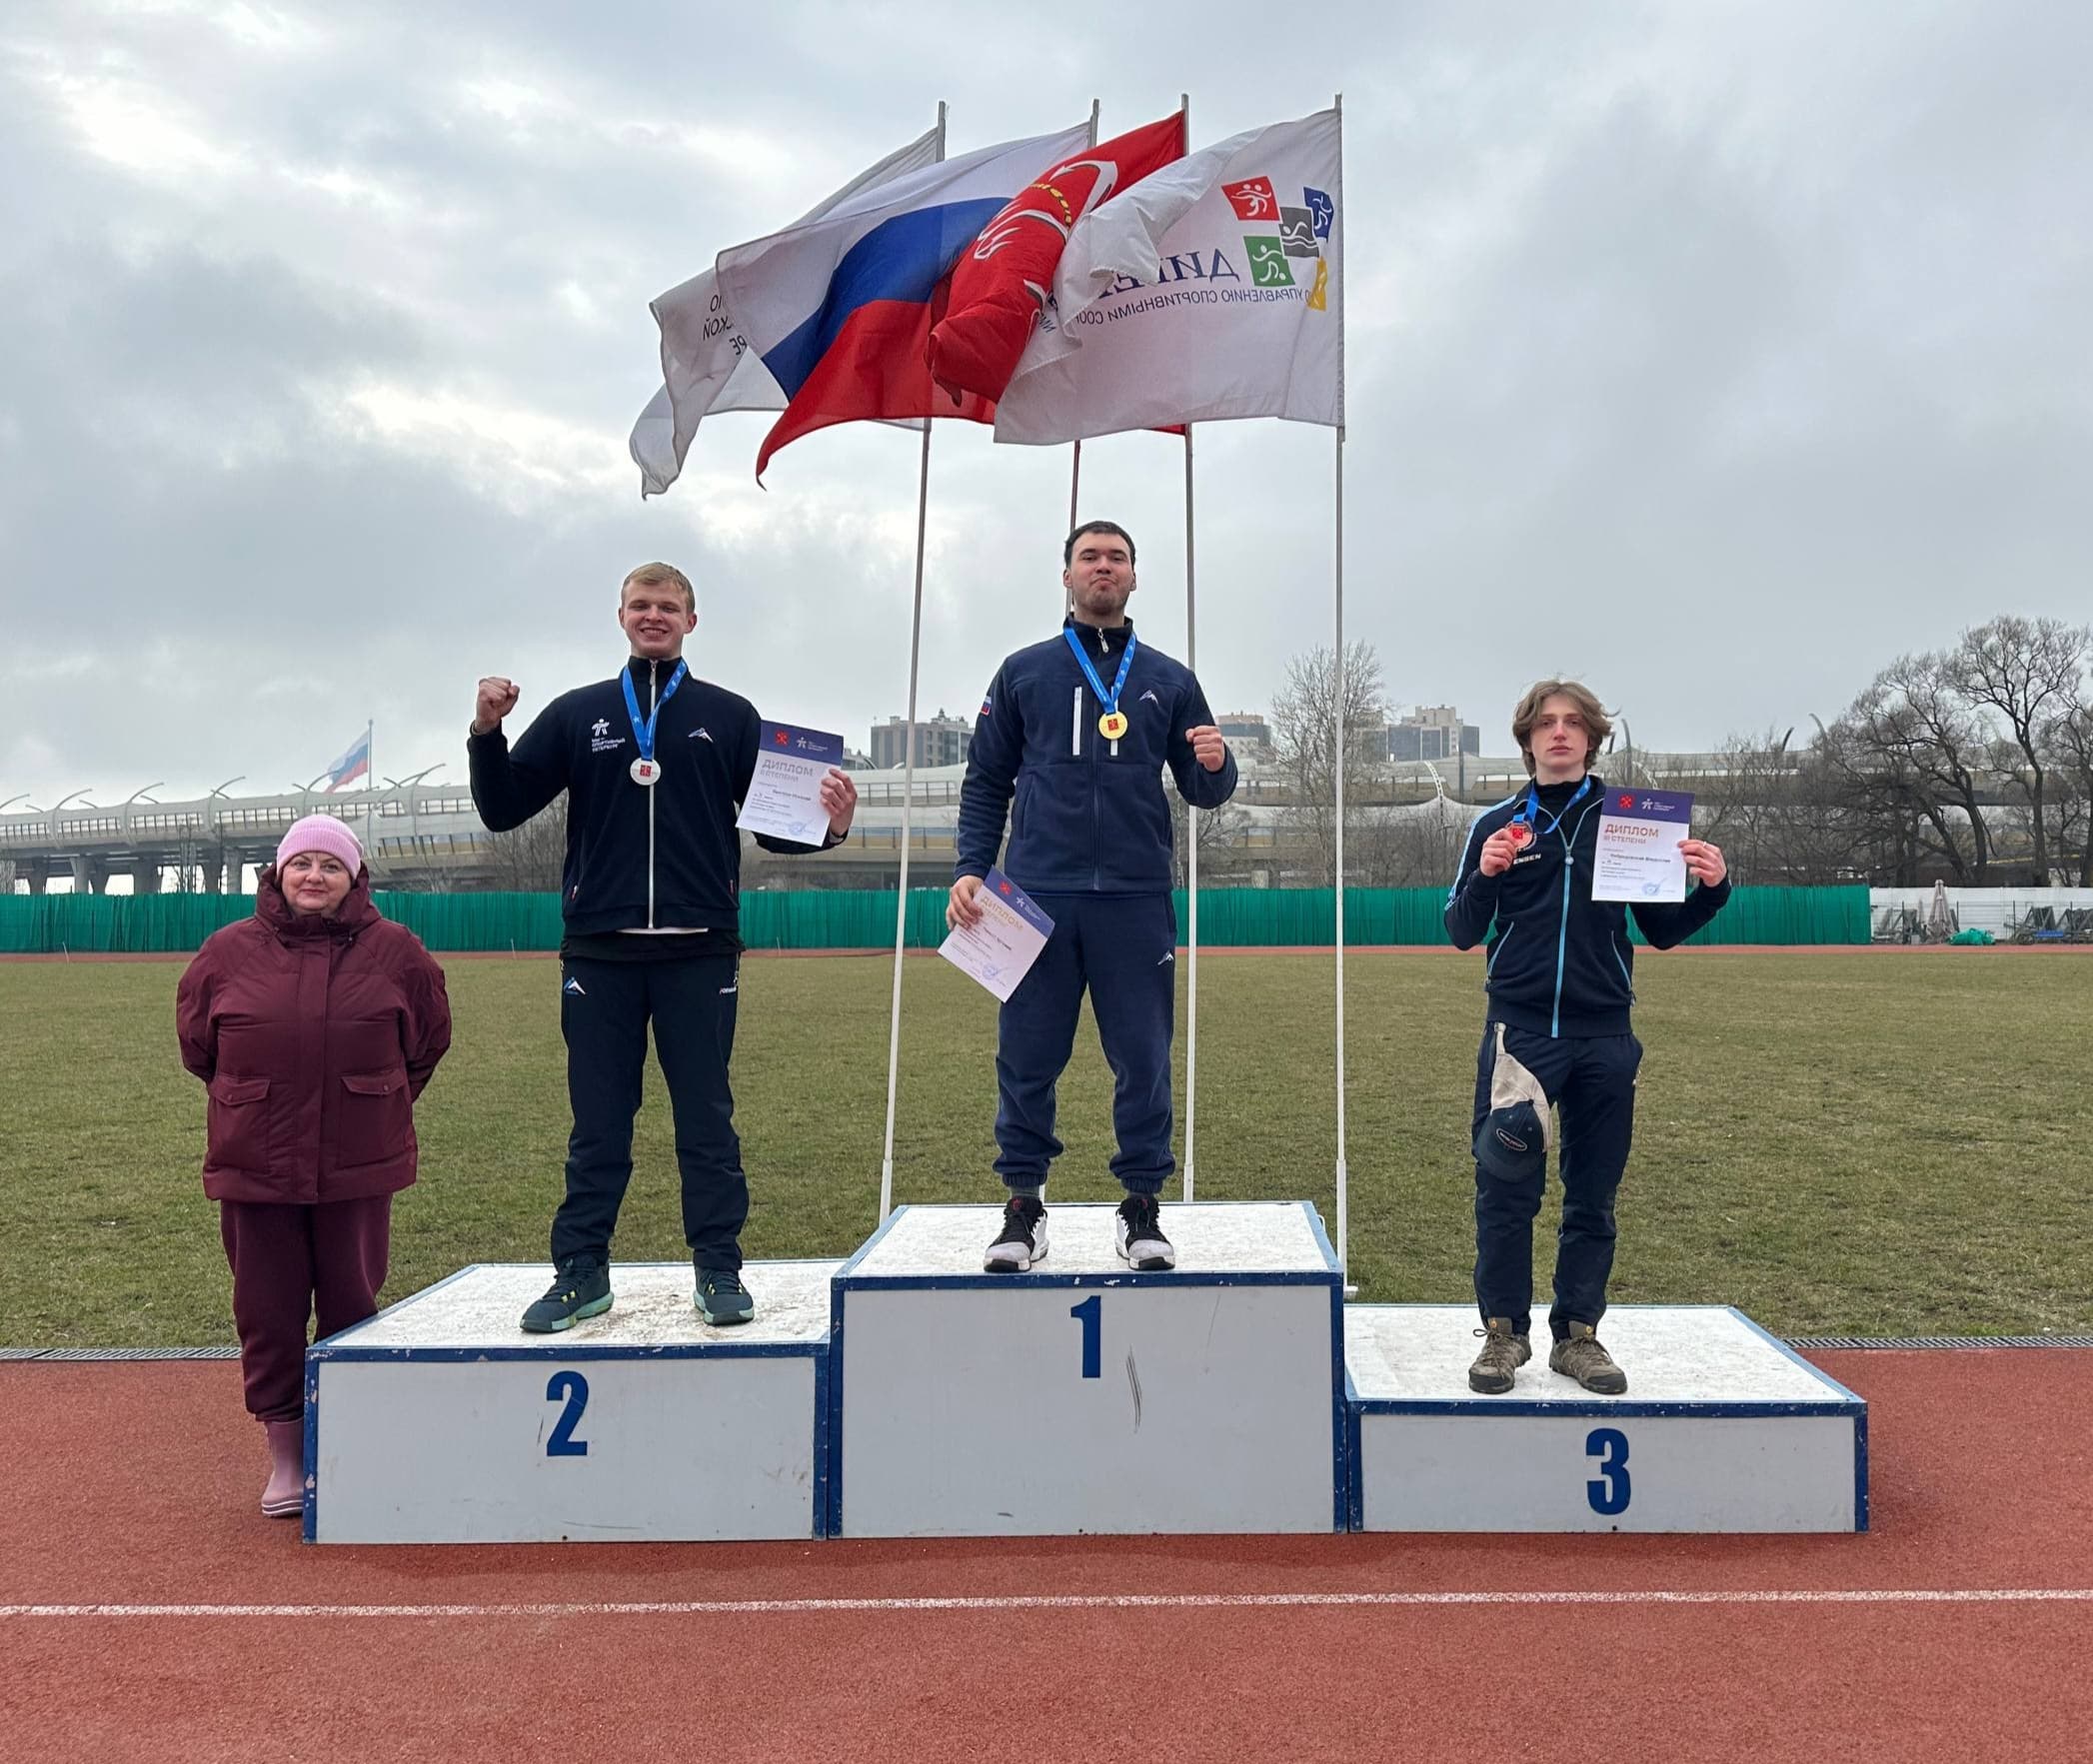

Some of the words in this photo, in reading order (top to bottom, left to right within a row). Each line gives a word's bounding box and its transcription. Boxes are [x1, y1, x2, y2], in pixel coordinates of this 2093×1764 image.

[762, 758, 815, 777] ДИПЛОМ
[1604, 823, 1659, 839] ДИПЛОМ
[1611, 836, 1646, 845] СТЕПЕНИ
[1071, 1296, 1100, 1379] 1
[547, 1371, 589, 1457] 2
[1586, 1428, 1632, 1516] 3
